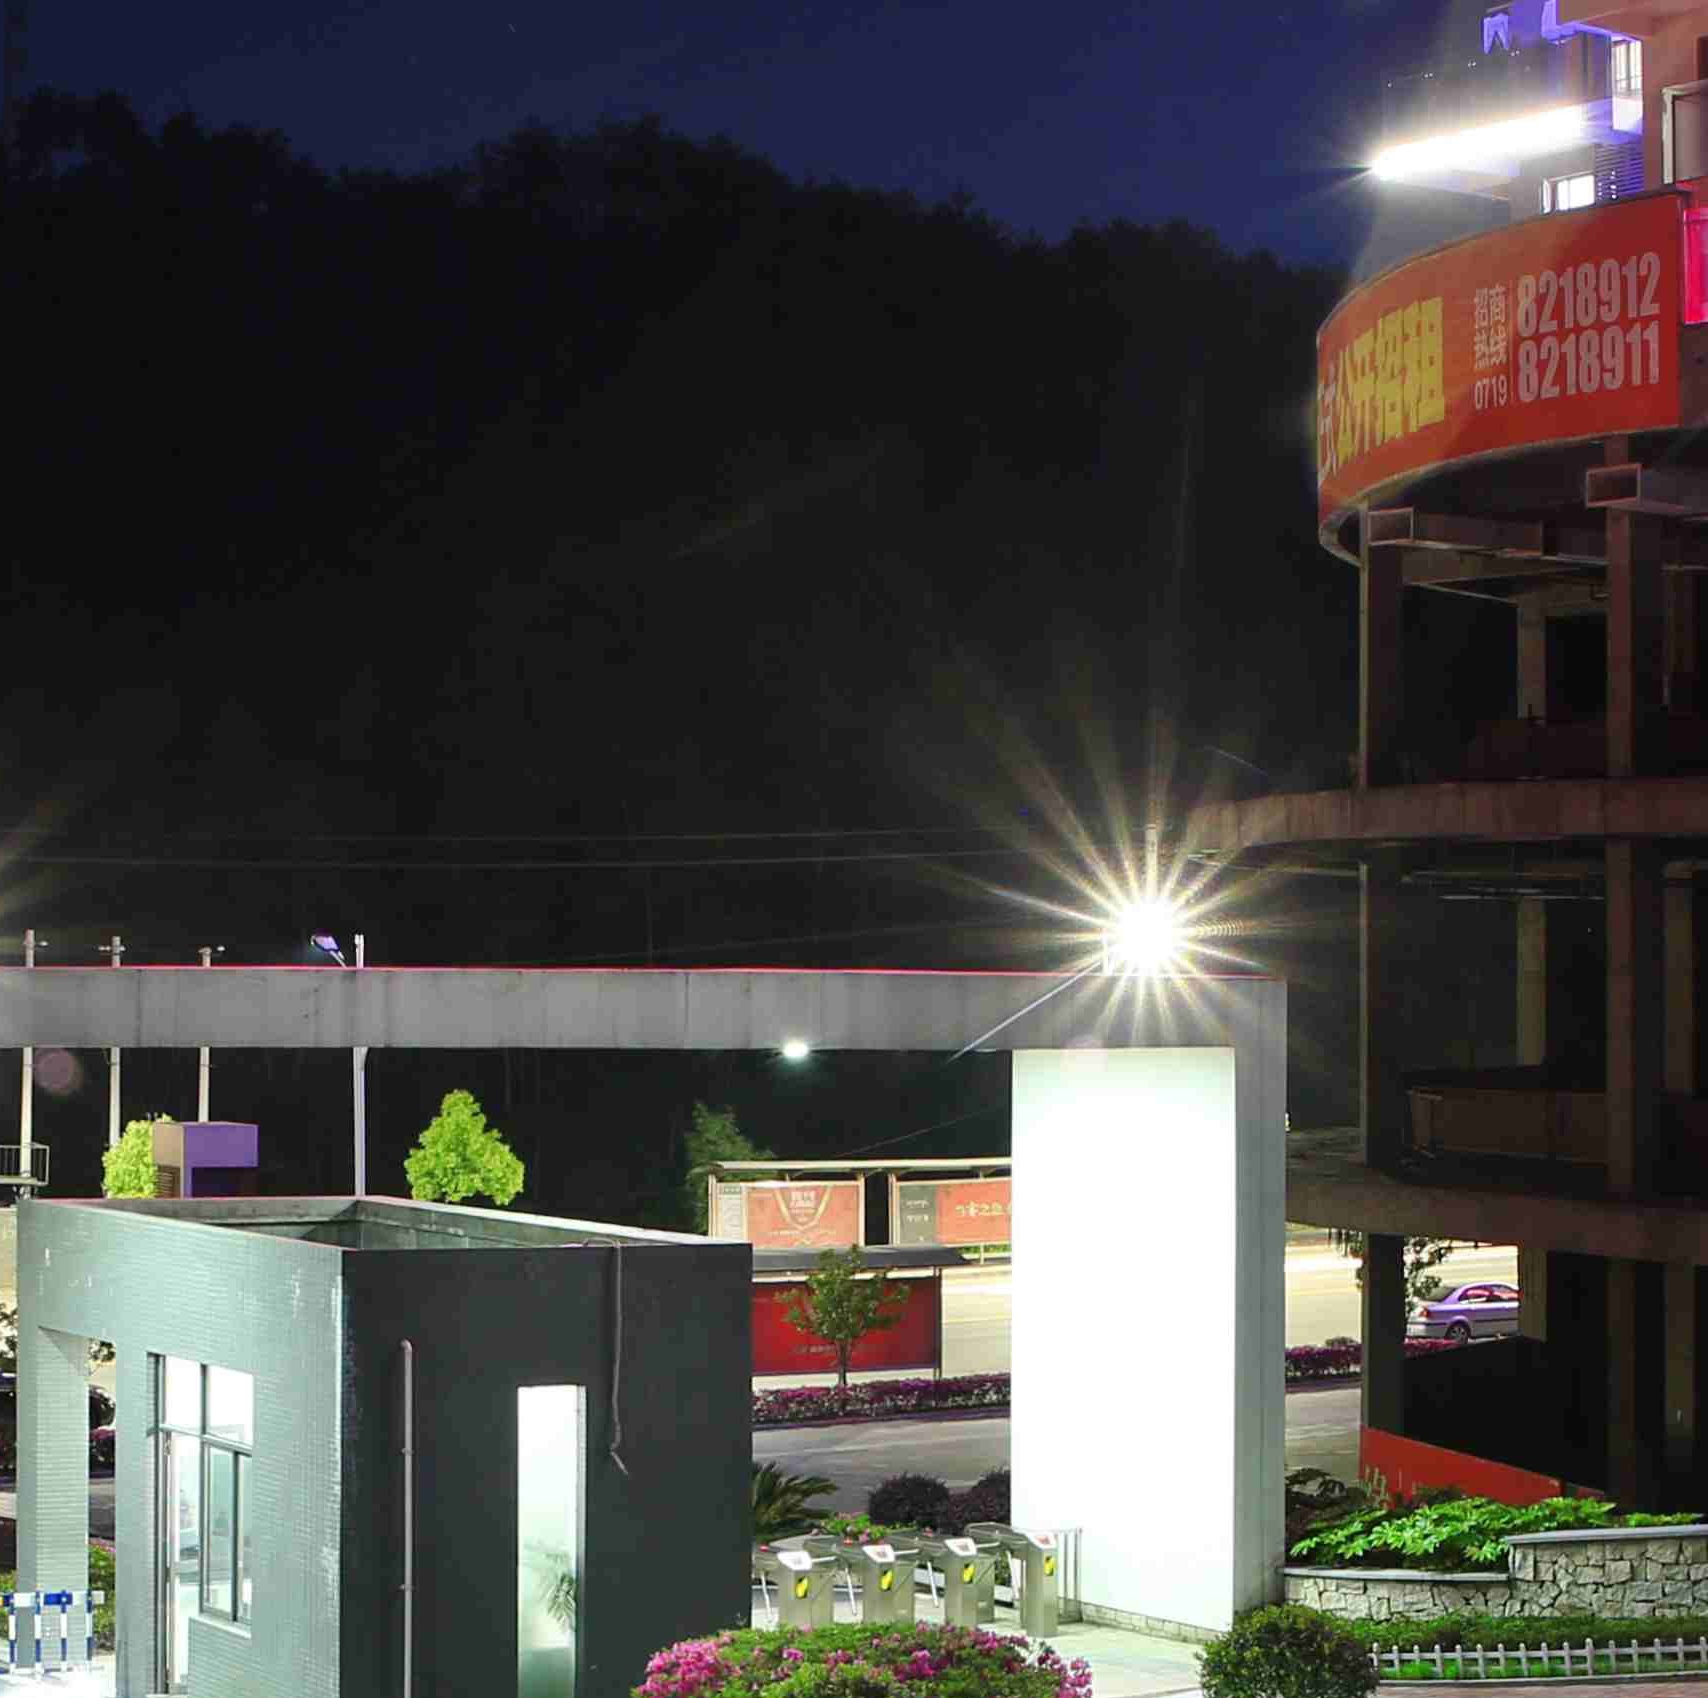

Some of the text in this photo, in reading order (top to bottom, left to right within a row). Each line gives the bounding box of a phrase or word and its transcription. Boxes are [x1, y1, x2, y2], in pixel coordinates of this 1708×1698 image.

[1474, 283, 1506, 328] 招商
[1517, 252, 1661, 337] 8218912
[1474, 325, 1507, 370] 热线
[1518, 320, 1659, 402] 8218911
[1475, 374, 1507, 411] 0719
